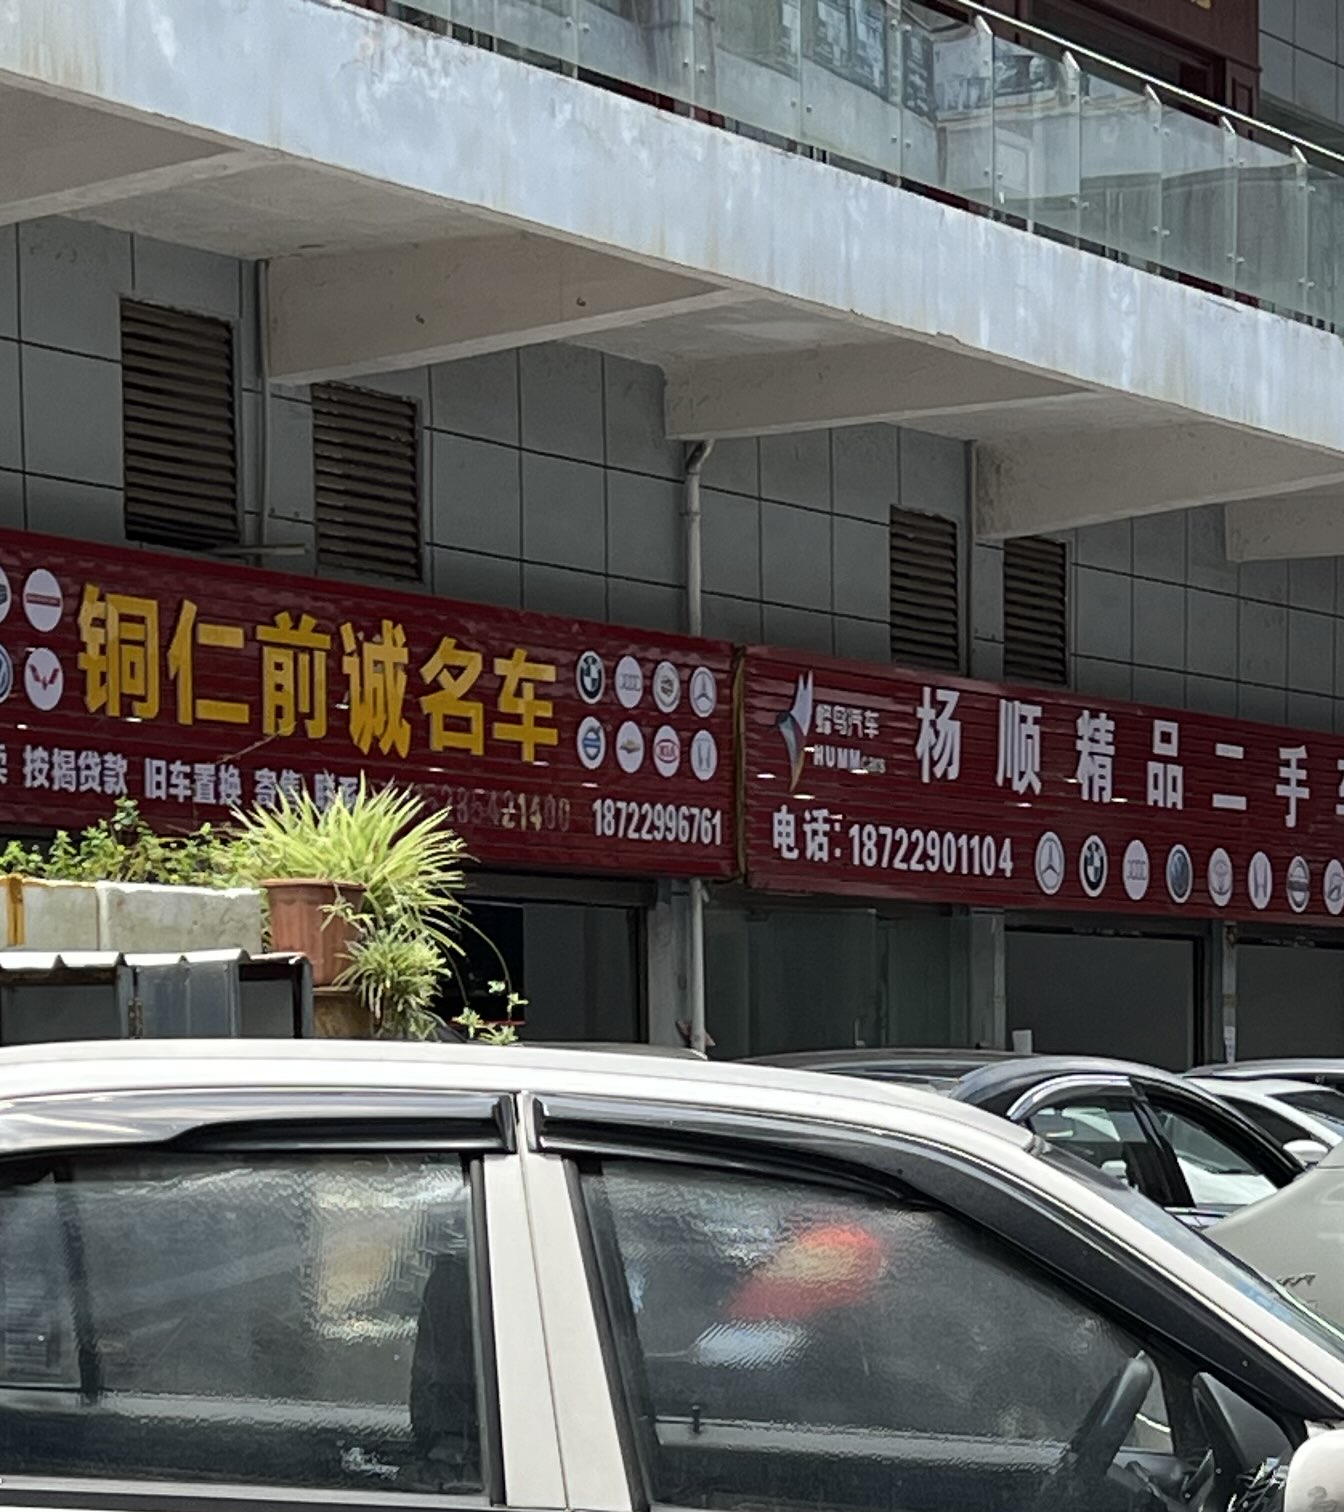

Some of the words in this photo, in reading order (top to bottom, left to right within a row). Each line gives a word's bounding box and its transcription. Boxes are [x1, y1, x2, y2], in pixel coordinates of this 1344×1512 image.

[77, 582, 559, 763] 铜仁前诚名车
[23, 744, 129, 796] 按揭贷款
[144, 757, 242, 807] 旧车置换
[593, 798, 722, 846] 18722996761
